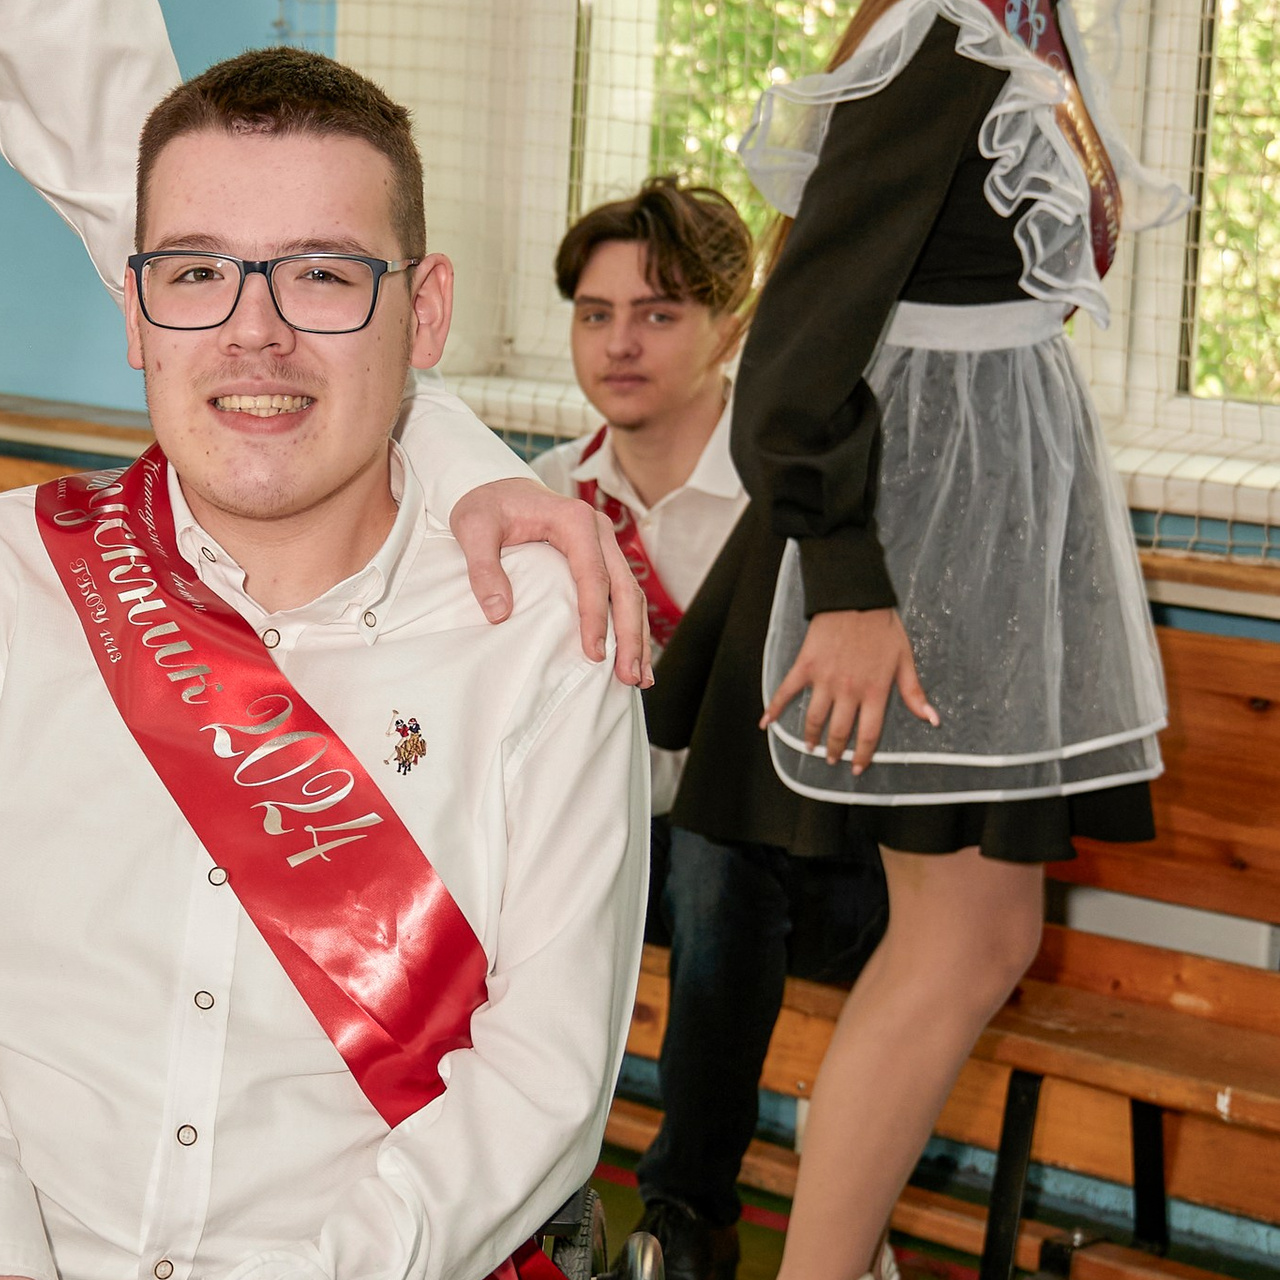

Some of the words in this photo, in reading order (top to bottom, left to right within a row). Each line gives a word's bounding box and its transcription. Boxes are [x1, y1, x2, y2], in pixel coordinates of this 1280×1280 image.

[70, 557, 110, 624] ГБОУ
[99, 628, 122, 663] 1413
[199, 694, 384, 869] 2024
